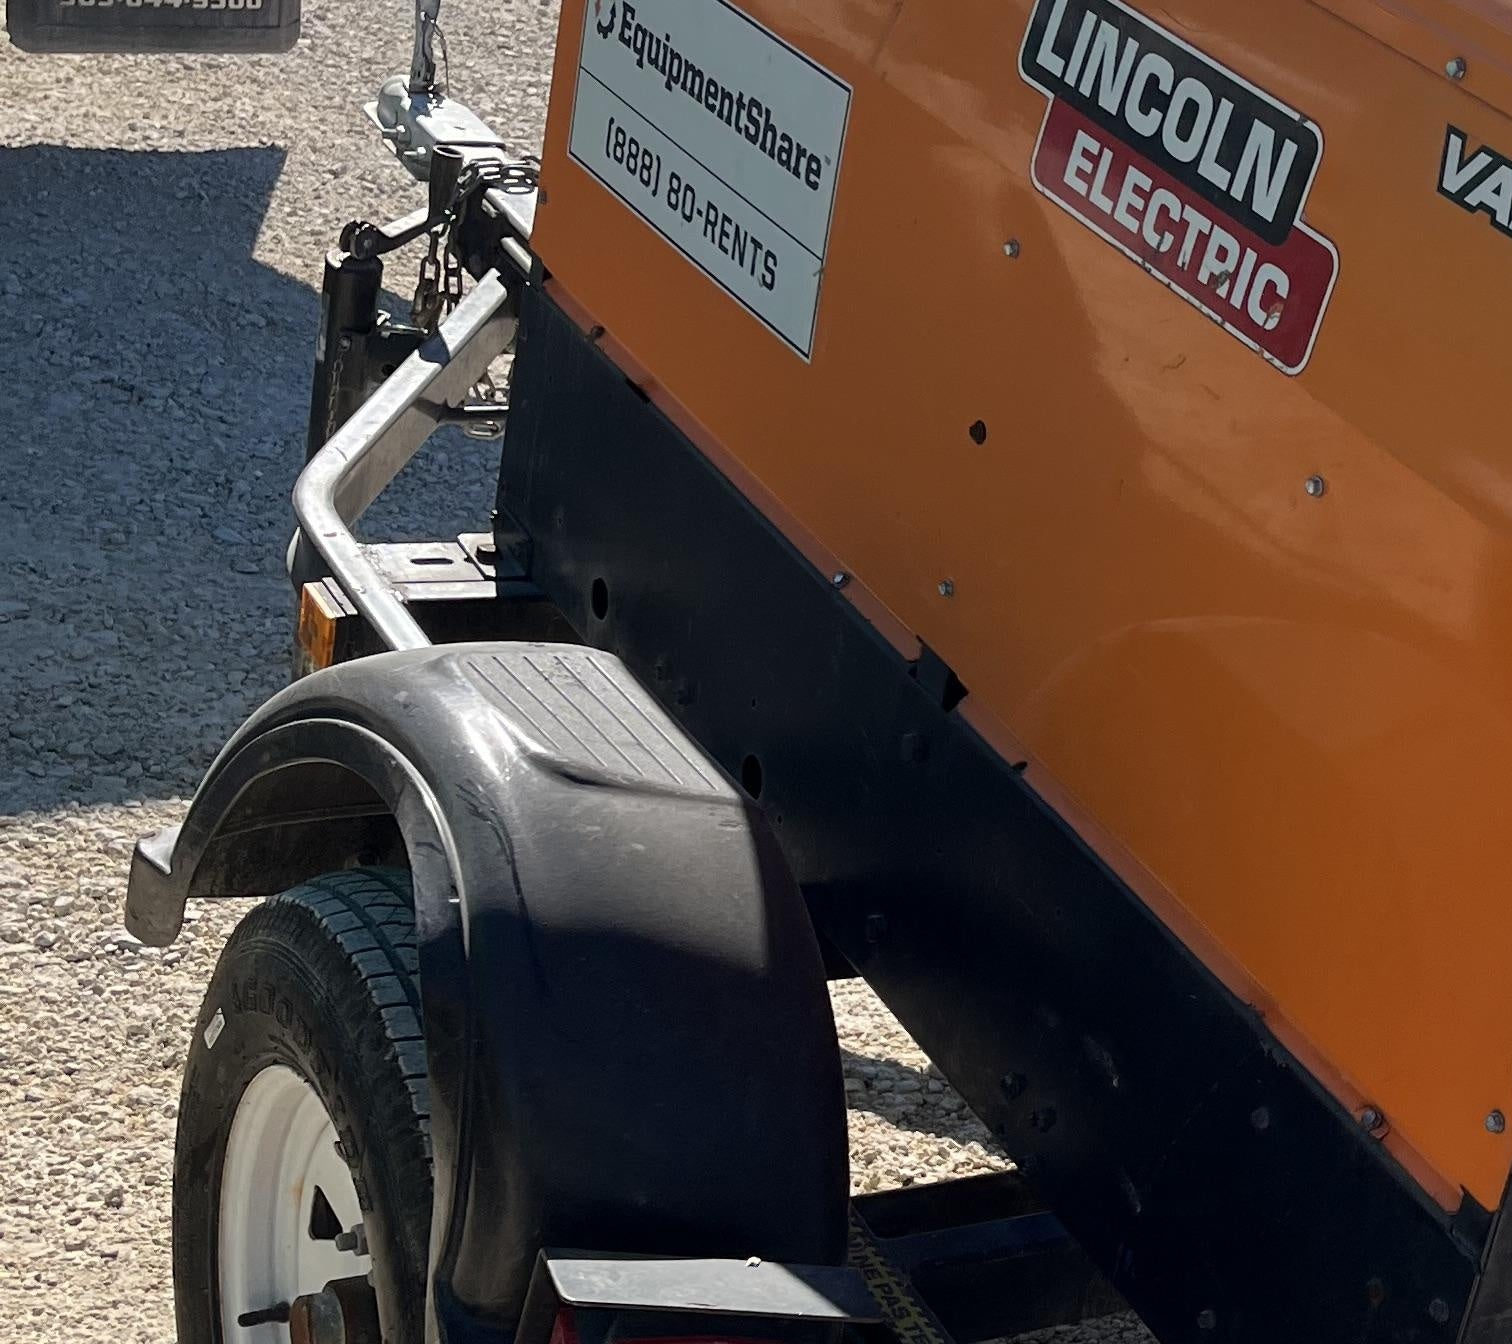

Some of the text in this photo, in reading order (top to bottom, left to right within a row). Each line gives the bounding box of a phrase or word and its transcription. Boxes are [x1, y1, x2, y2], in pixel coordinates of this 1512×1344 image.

[618, 0, 822, 191] EquipmentShare
[605, 116, 778, 292] (888) 80-RENTS
[1063, 129, 1290, 331] ELECTRIC
